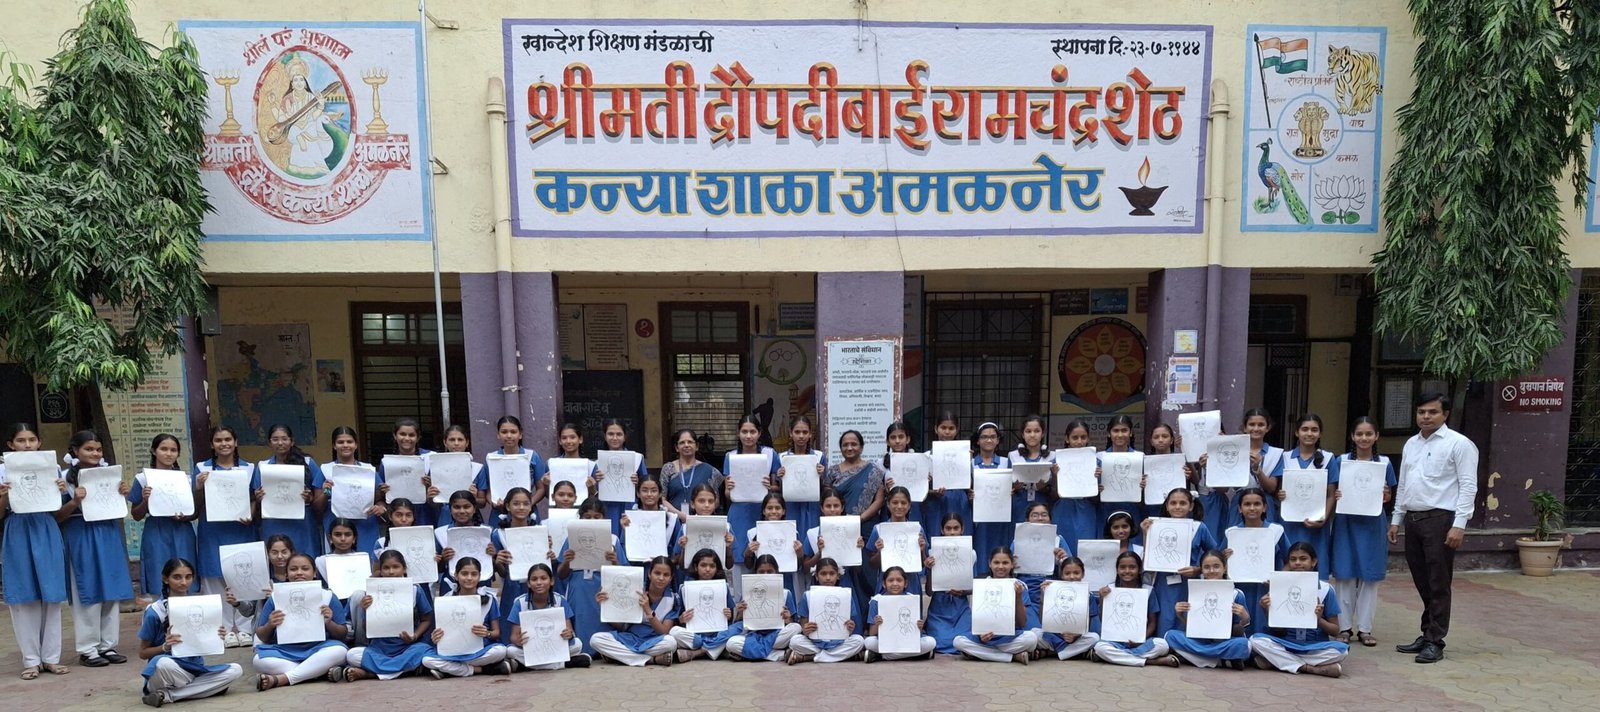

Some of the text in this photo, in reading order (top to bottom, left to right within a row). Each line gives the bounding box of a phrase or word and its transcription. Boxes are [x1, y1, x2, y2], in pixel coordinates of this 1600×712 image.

[522, 28, 714, 55] खान्देश शिक्षण मंडळाची
[1050, 38, 1107, 59] स्थापना
[526, 60, 700, 144] श्रीमती
[704, 58, 931, 151] द्रौपदीबाई
[532, 152, 1106, 218] कन्या शाळा अमळनेर
[1519, 398, 1562, 406] NO SMOKING
